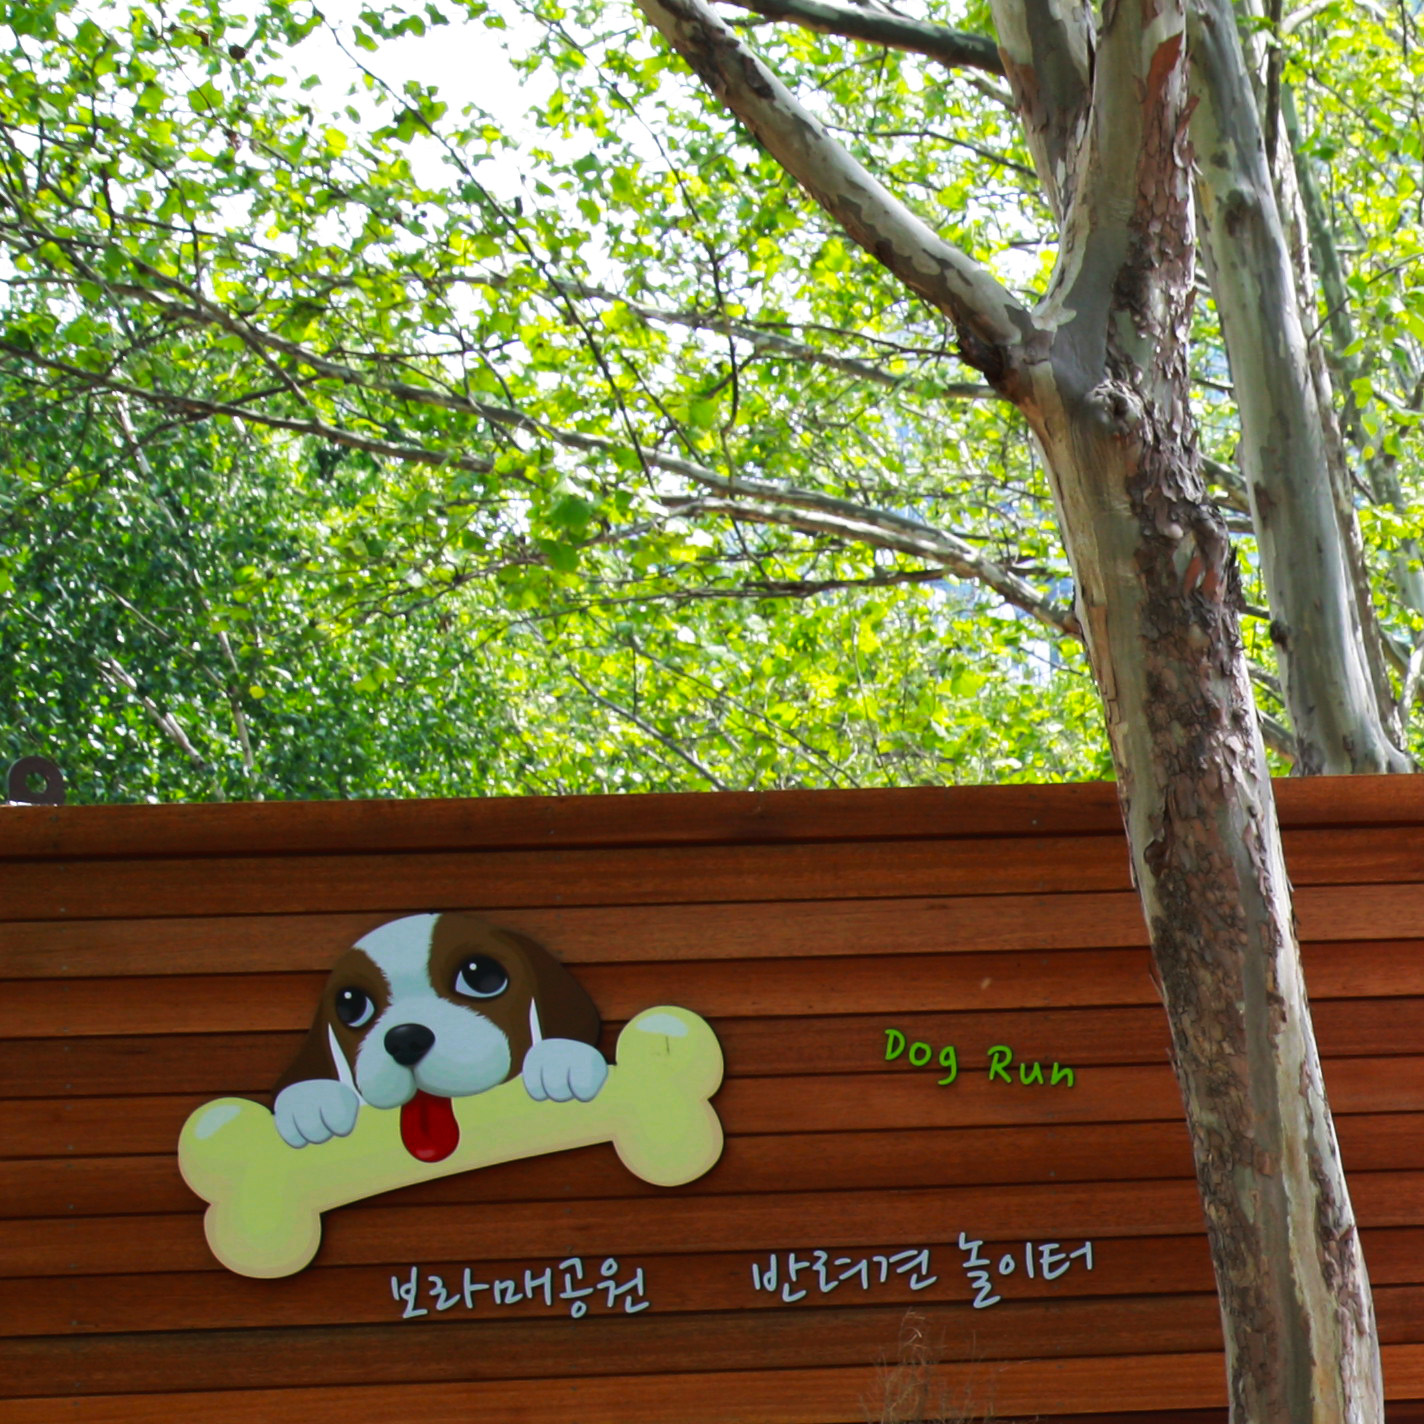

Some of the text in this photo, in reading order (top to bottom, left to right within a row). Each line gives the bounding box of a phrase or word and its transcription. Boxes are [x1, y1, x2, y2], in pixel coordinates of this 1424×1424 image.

[884, 1029, 1075, 1087] Dog Run
[391, 1232, 1093, 1319] 보라매공원 반려견 놀이터
